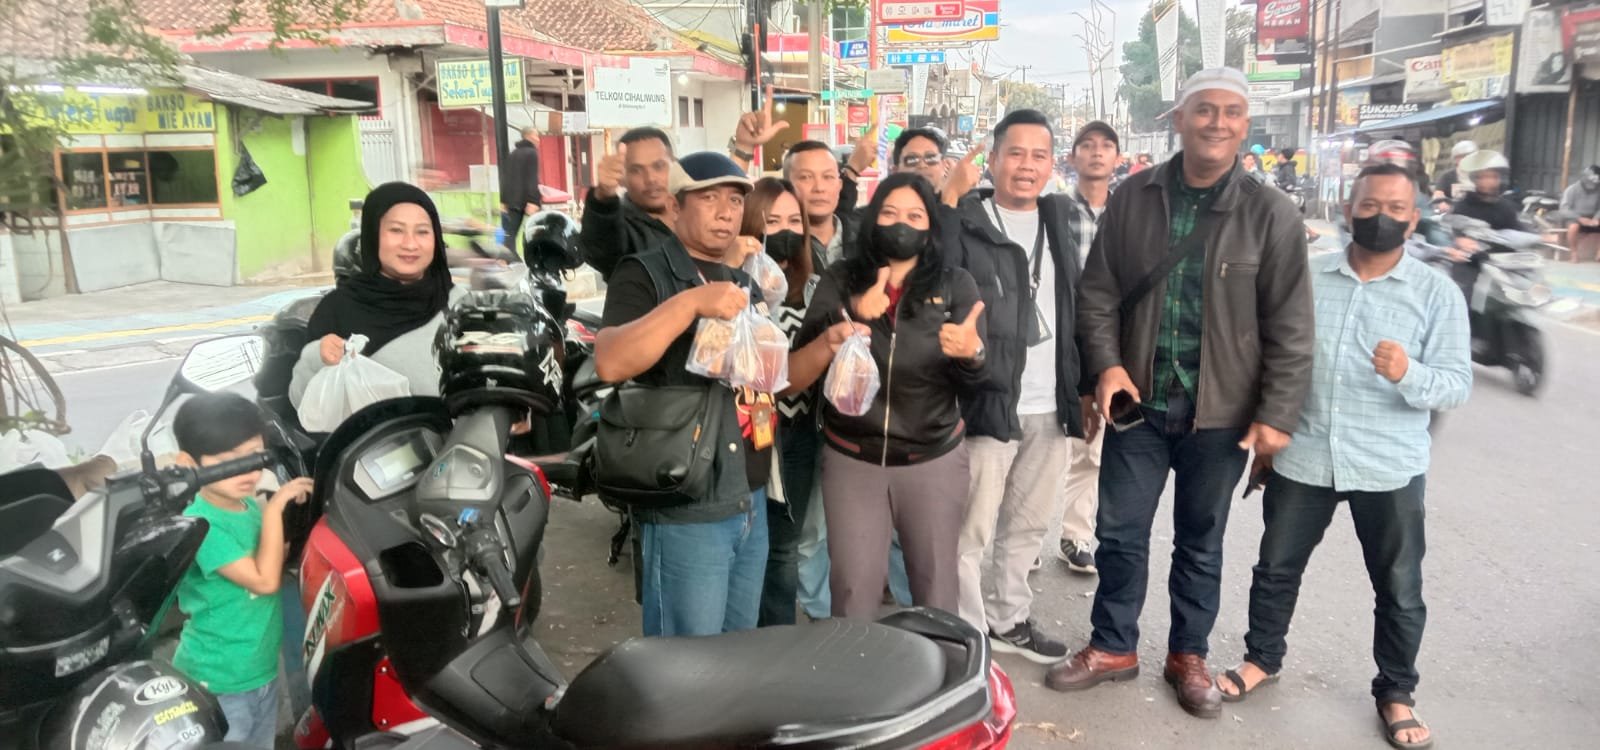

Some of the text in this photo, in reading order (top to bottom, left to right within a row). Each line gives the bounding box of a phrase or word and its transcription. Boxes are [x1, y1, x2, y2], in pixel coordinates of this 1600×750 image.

[1411, 59, 1443, 72] Can
[595, 90, 623, 101] TELKOM
[147, 95, 185, 113] BAKSO
[1360, 103, 1419, 114] SUKARASA
[158, 111, 213, 130] MIE AYAM
